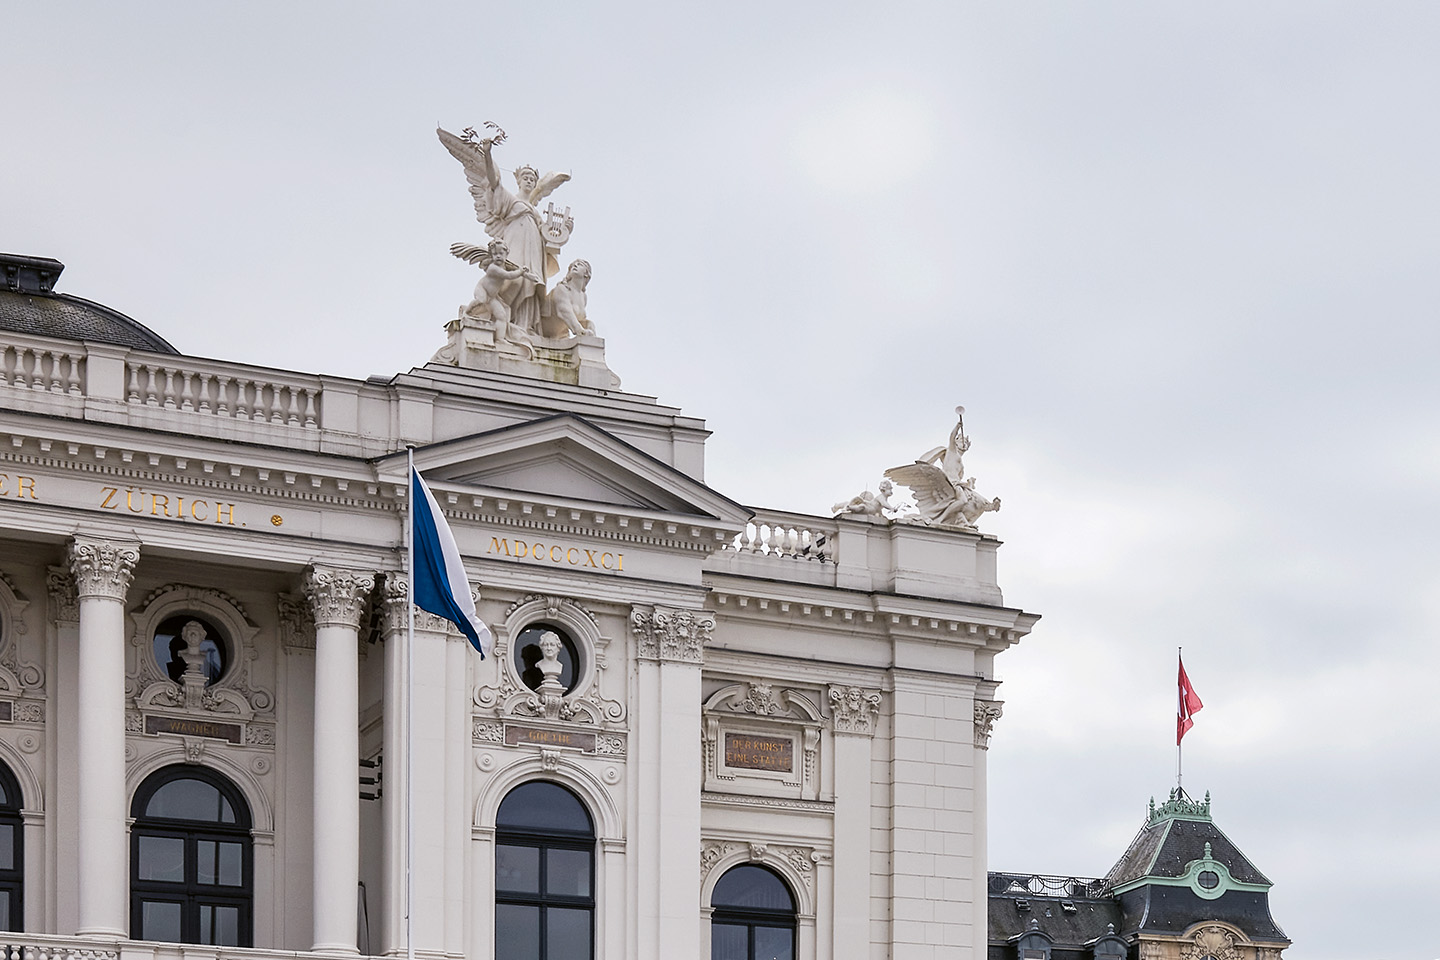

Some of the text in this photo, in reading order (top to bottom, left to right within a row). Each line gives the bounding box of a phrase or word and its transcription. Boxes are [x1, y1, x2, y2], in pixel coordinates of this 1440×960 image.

[486, 536, 624, 572] MDCCCXCI
[170, 722, 219, 735] WAGNER
[732, 739, 784, 752] DER KUNST
